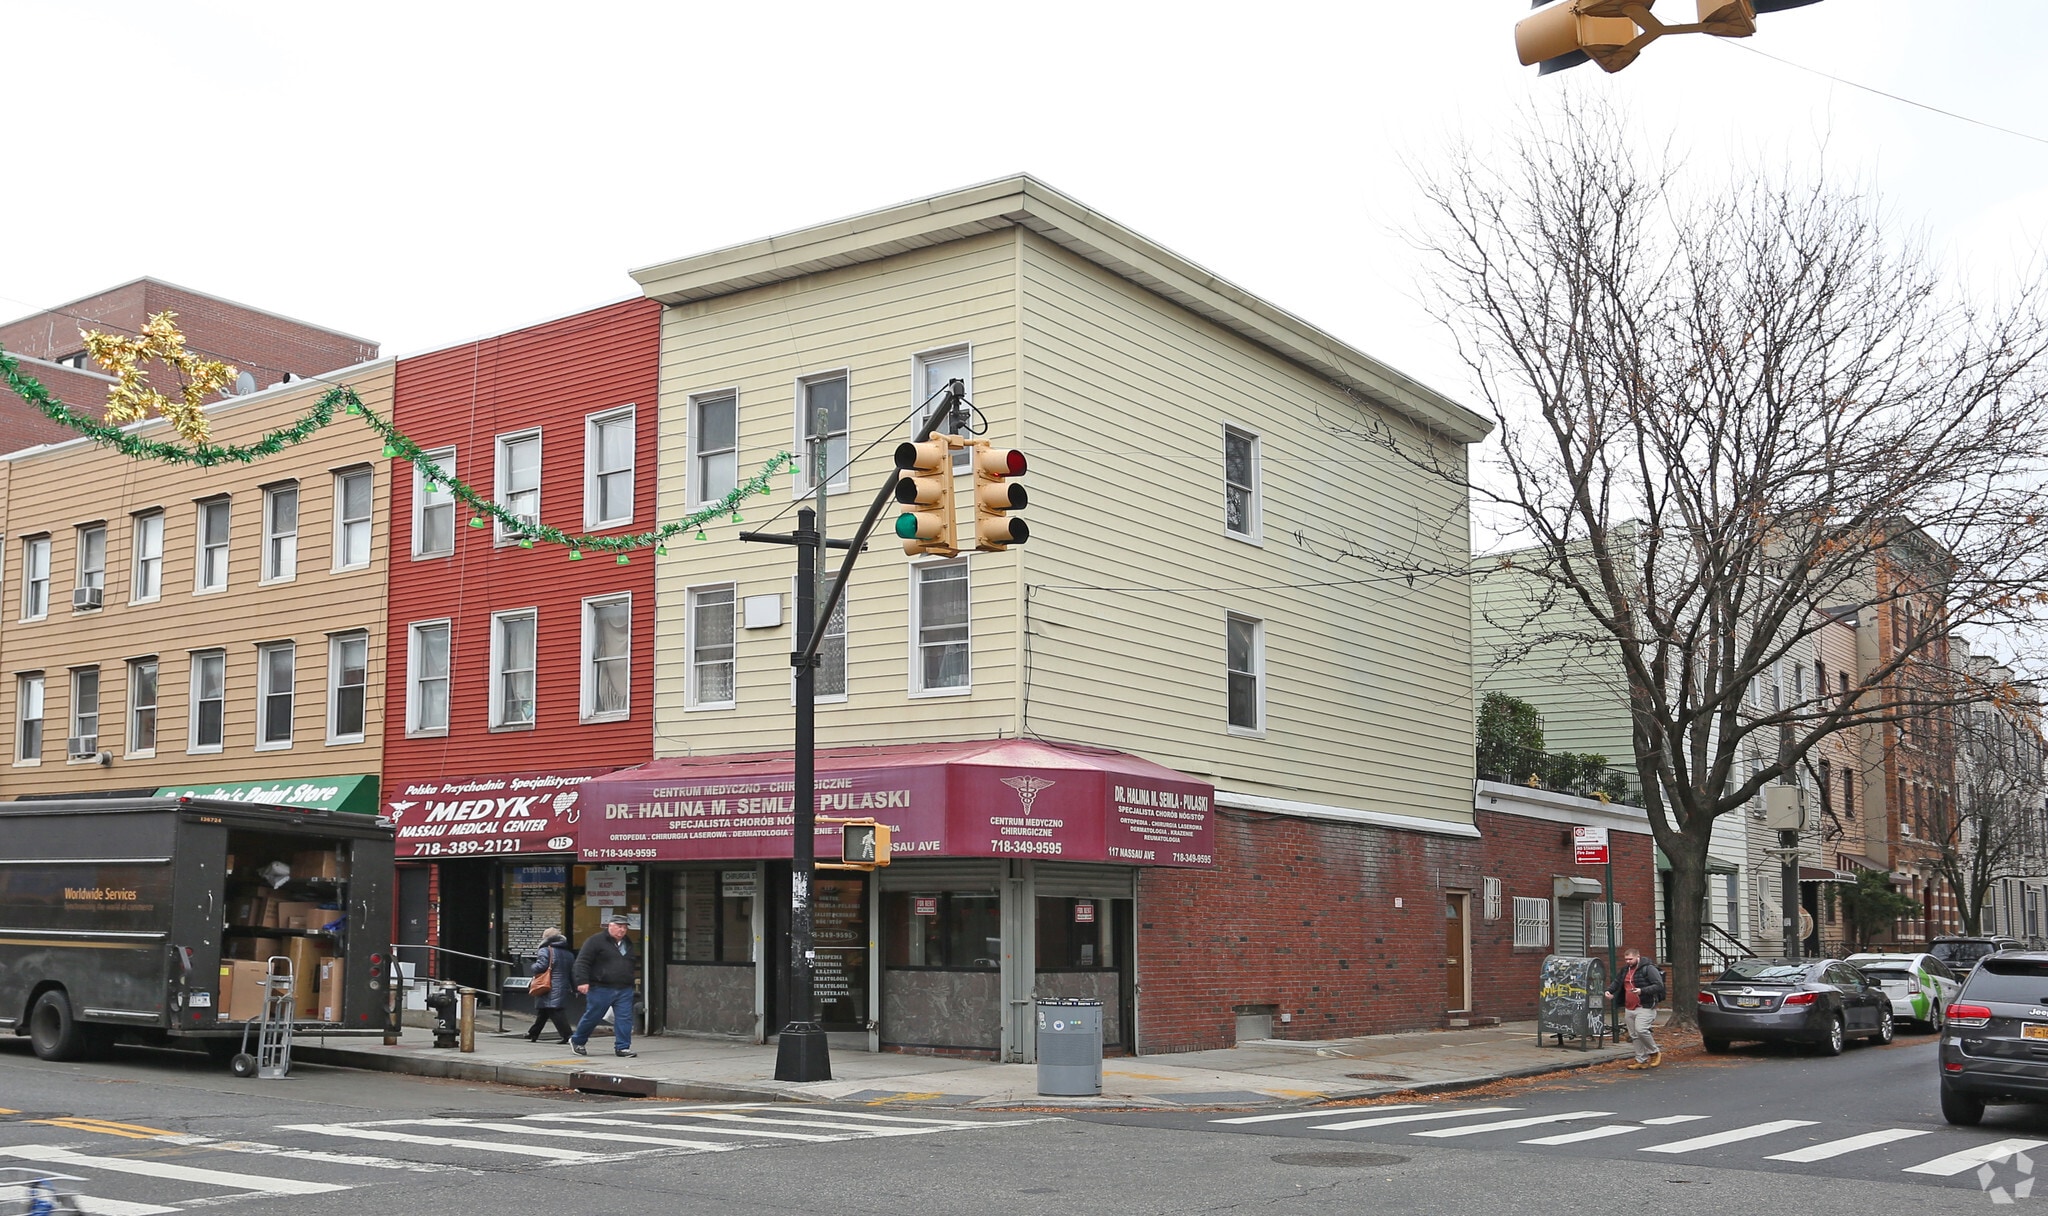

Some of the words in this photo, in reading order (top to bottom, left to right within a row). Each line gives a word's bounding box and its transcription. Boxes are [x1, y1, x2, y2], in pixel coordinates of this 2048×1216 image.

[242, 784, 294, 804] Paint
[286, 783, 339, 803] Store
[404, 784, 438, 795] Polska
[440, 779, 506, 796] Przychodnia
[653, 786, 701, 798] CENTRUM
[703, 783, 760, 795] MEDYCZNO
[769, 777, 853, 793] CHIRGICZNE
[605, 803, 633, 820] DR.
[638, 800, 705, 818] HALINA
[711, 799, 731, 816] M.
[820, 789, 910, 811] PULASKI
[1114, 785, 1126, 803] DR.
[1126, 787, 1150, 806] HALINA
[1151, 790, 1158, 807] M.
[1159, 791, 1179, 809] SEMLA
[1183, 794, 1208, 812] PULASKI
[1118, 805, 1155, 817] SPECJALISTA
[1155, 809, 1178, 819] CHORÓB
[397, 824, 447, 837] NASSAU
[447, 821, 499, 835] MEDICAL
[502, 819, 548, 833] CENTER
[669, 818, 730, 829] SPECJALISTA
[733, 815, 775, 827] CHORÓB
[990, 816, 1024, 826] CENTRUM
[1025, 818, 1063, 828] MEDYCZNO
[1120, 817, 1148, 826] ORTOPEDIA
[1151, 820, 1177, 829] CHIRURGIA
[1178, 822, 1202, 831] LASEROWA
[610, 833, 646, 841] ORTOPEDIA
[651, 832, 688, 840] CHIRURGIA
[689, 831, 727, 839] LASEROWA
[732, 829, 788, 837] DERMATOLOGIA
[1000, 827, 1053, 837] CHIRURGICZNE
[1130, 826, 1167, 835] DERMATOLOGIA
[553, 838, 567, 847] 115
[918, 840, 940, 851] AVE
[1143, 834, 1180, 843] REUMATOLOGIA
[413, 839, 520, 855] 718-389-2121
[582, 848, 598, 857] Tel:
[600, 848, 657, 857] 718-349-9595
[990, 840, 1062, 855] 718-349-9595
[1108, 846, 1119, 857] 117
[1120, 847, 1143, 859] NASSAU
[1143, 850, 1155, 860] AVE
[1172, 852, 1211, 864] 718-349-9595
[64, 887, 103, 900] Worldwide
[104, 887, 137, 900] Services
[439, 1019, 446, 1029] 2
